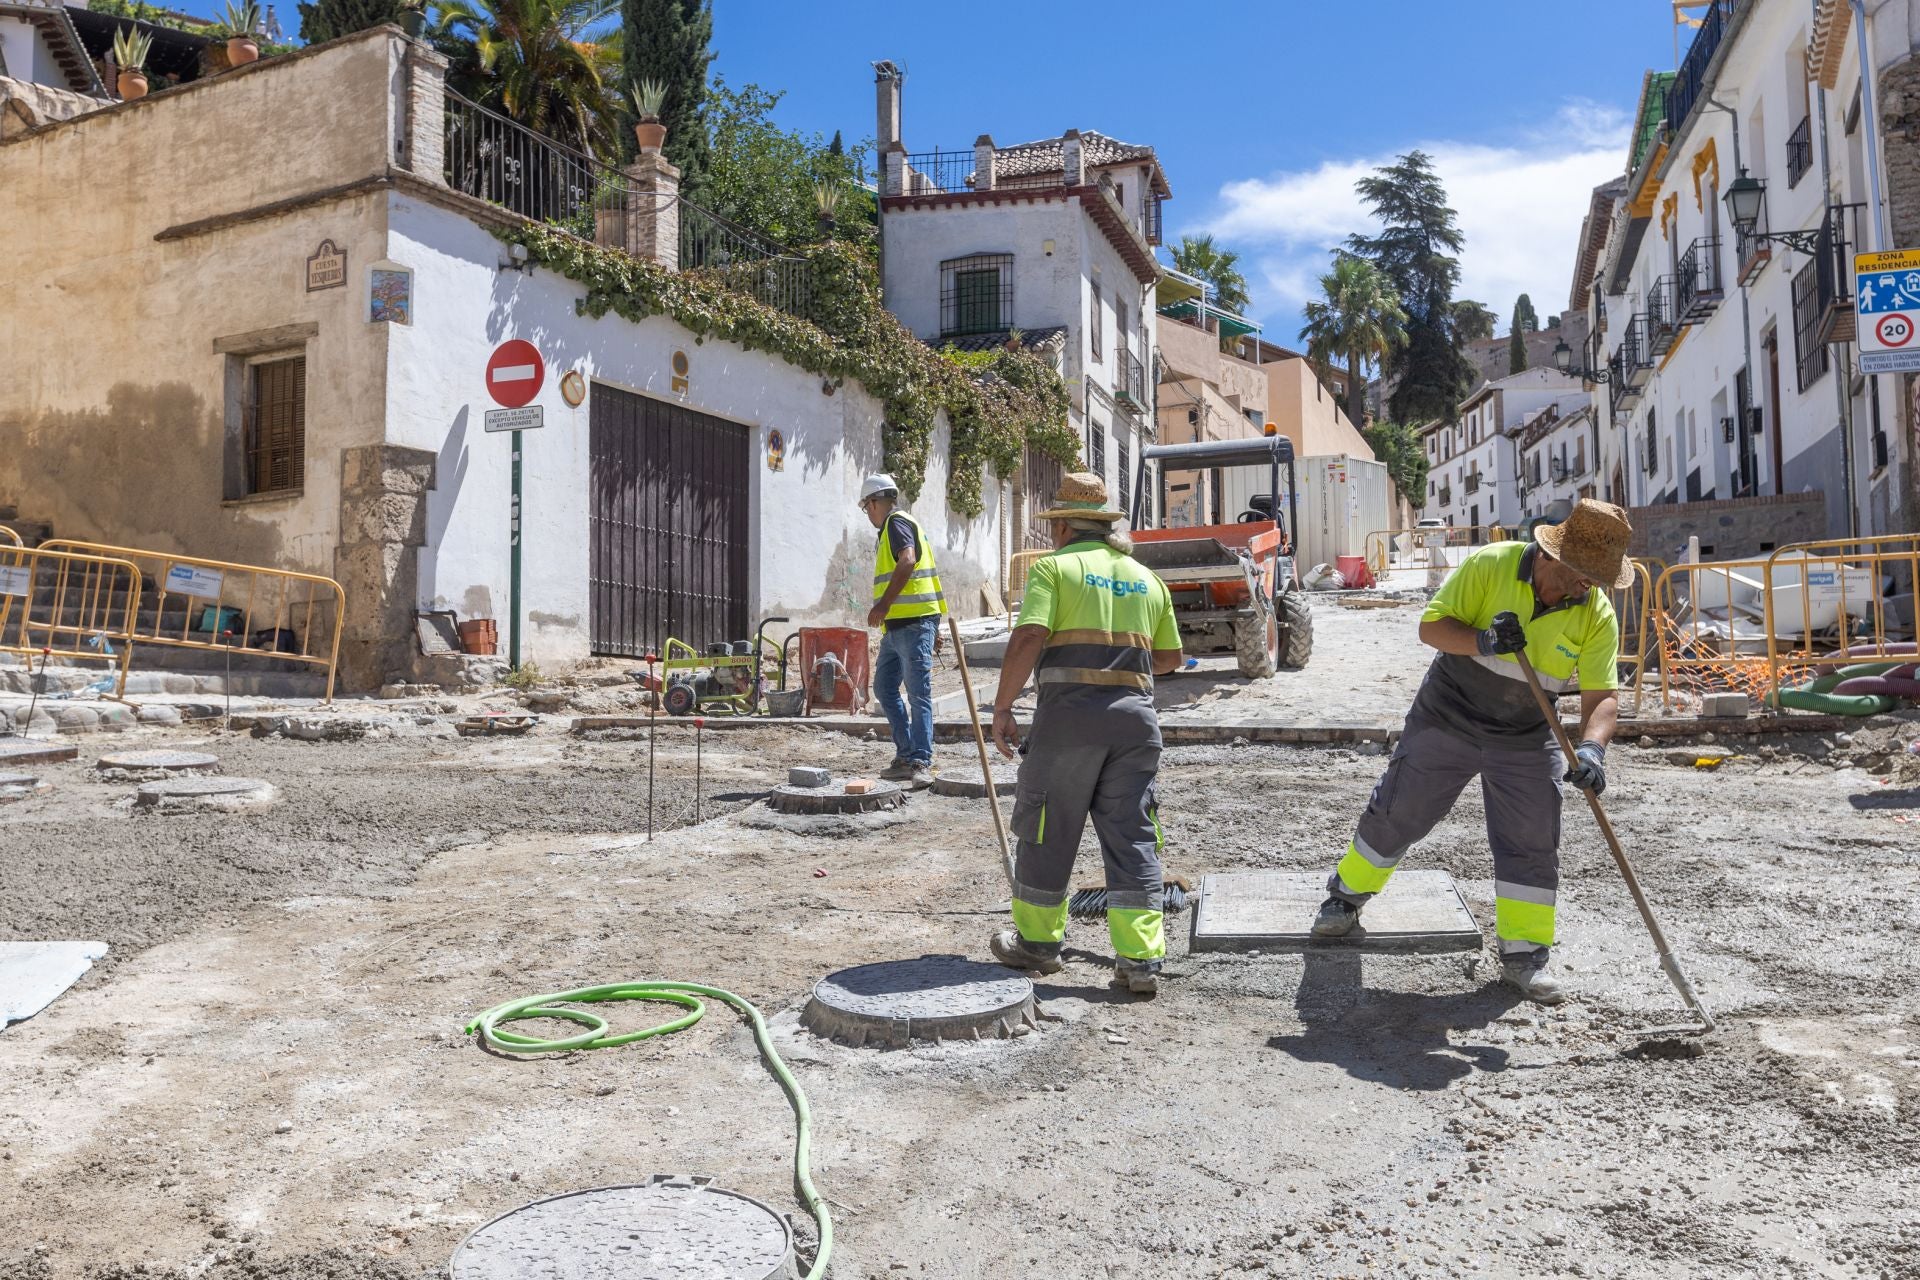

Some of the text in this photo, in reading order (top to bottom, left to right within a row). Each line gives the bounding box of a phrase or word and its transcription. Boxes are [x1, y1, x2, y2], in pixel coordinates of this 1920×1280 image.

[1877, 252, 1905, 261] ZONA
[315, 259, 338, 270] CUESTA
[1884, 324, 1906, 336] 20
[1863, 363, 1873, 371] EN
[1873, 362, 1893, 370] ZONAS
[496, 419, 533, 428] AUTORIZADOS
